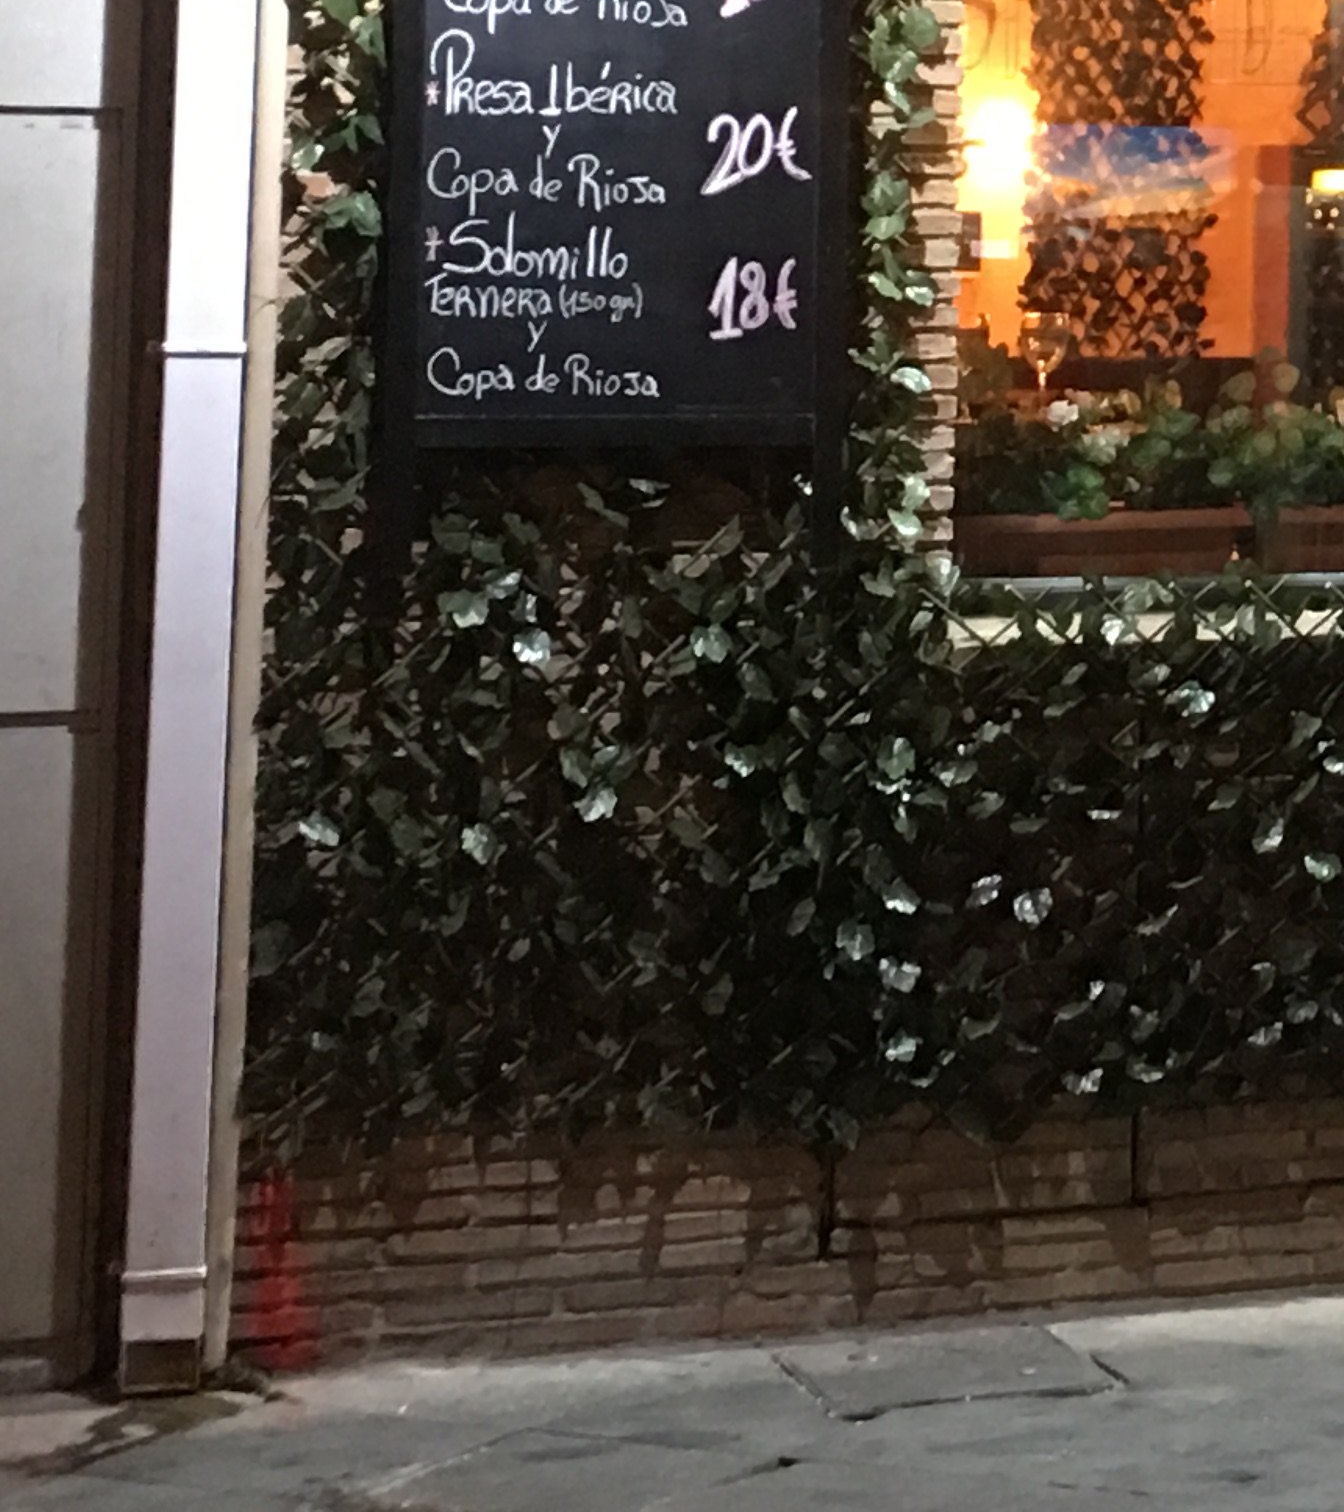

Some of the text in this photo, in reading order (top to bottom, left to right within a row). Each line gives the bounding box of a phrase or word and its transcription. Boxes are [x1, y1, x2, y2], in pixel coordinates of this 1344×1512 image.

[427, 147, 519, 216] Copa
[529, 154, 562, 201] de
[700, 107, 812, 196] 20€
[442, 210, 628, 280] Solomillo
[709, 257, 797, 341] 18€
[427, 347, 515, 400] Copa
[525, 354, 560, 393] de
